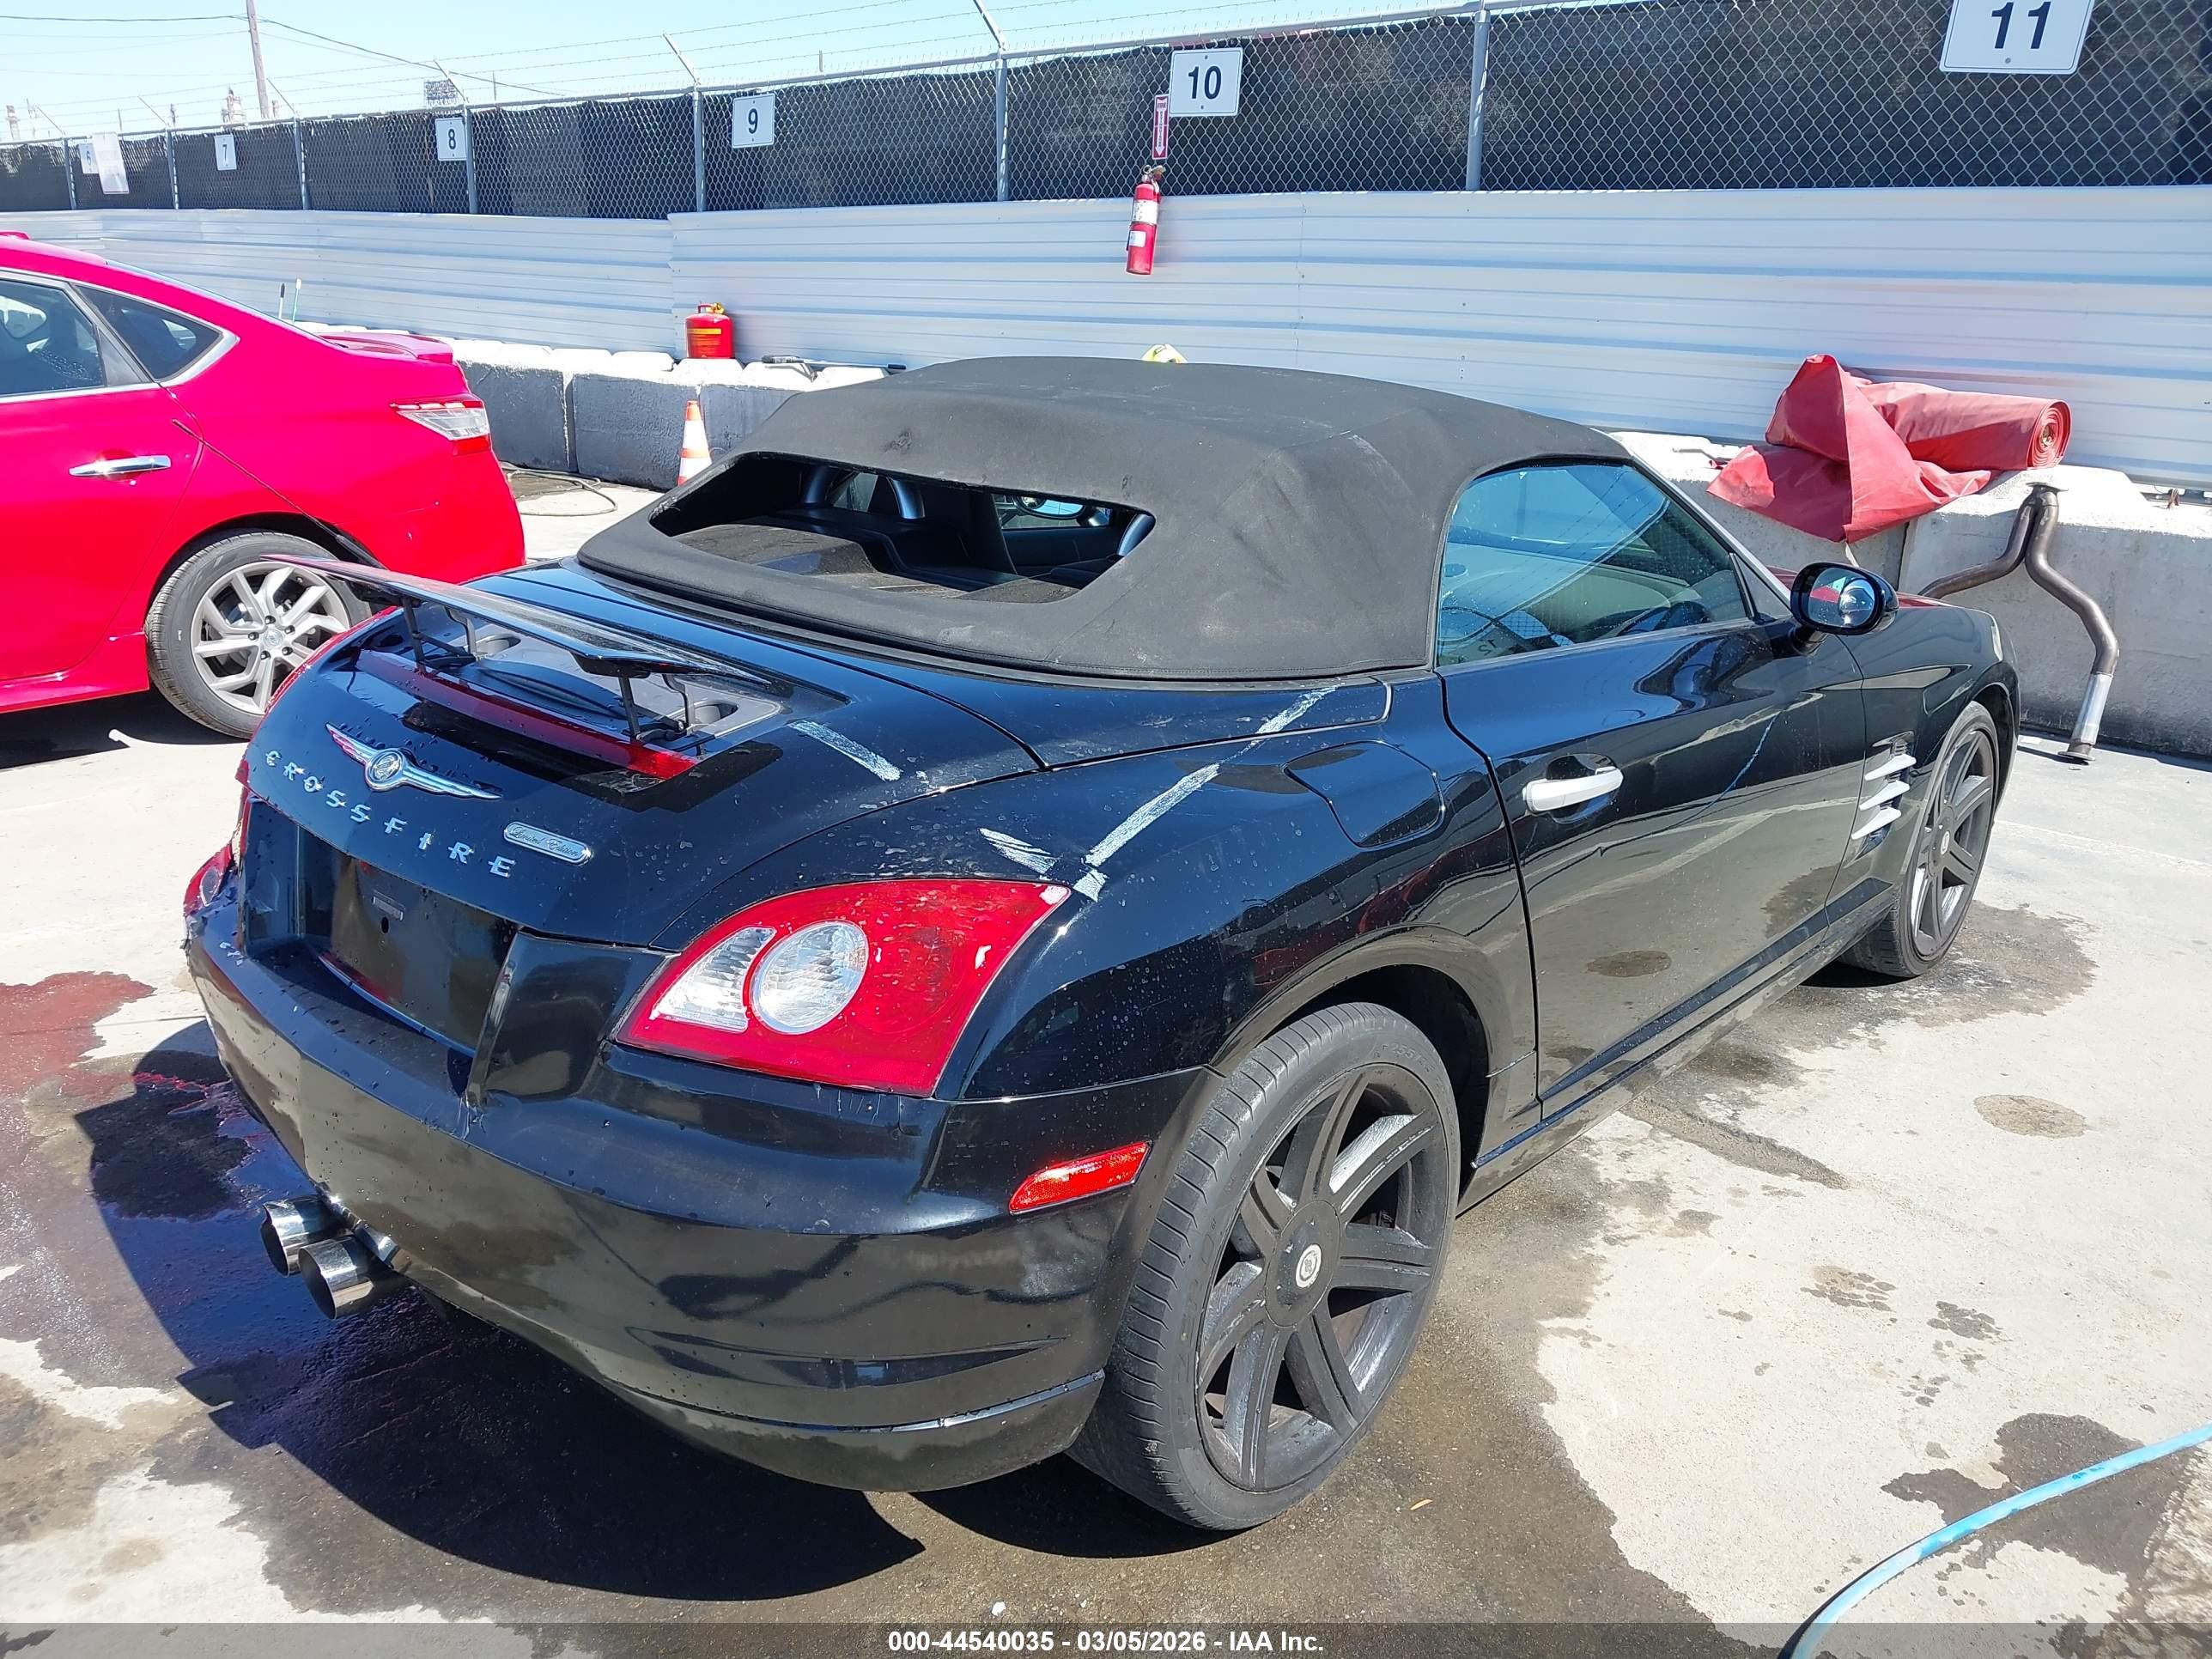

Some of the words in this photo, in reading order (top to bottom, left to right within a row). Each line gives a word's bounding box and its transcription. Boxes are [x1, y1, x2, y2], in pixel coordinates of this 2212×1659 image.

[1990, 1, 2051, 50] 11
[1188, 65, 1222, 100] 10
[748, 107, 758, 135] 9
[222, 143, 228, 162] 7
[447, 128, 457, 150] 8
[264, 750, 517, 878] CROSSFIRE
